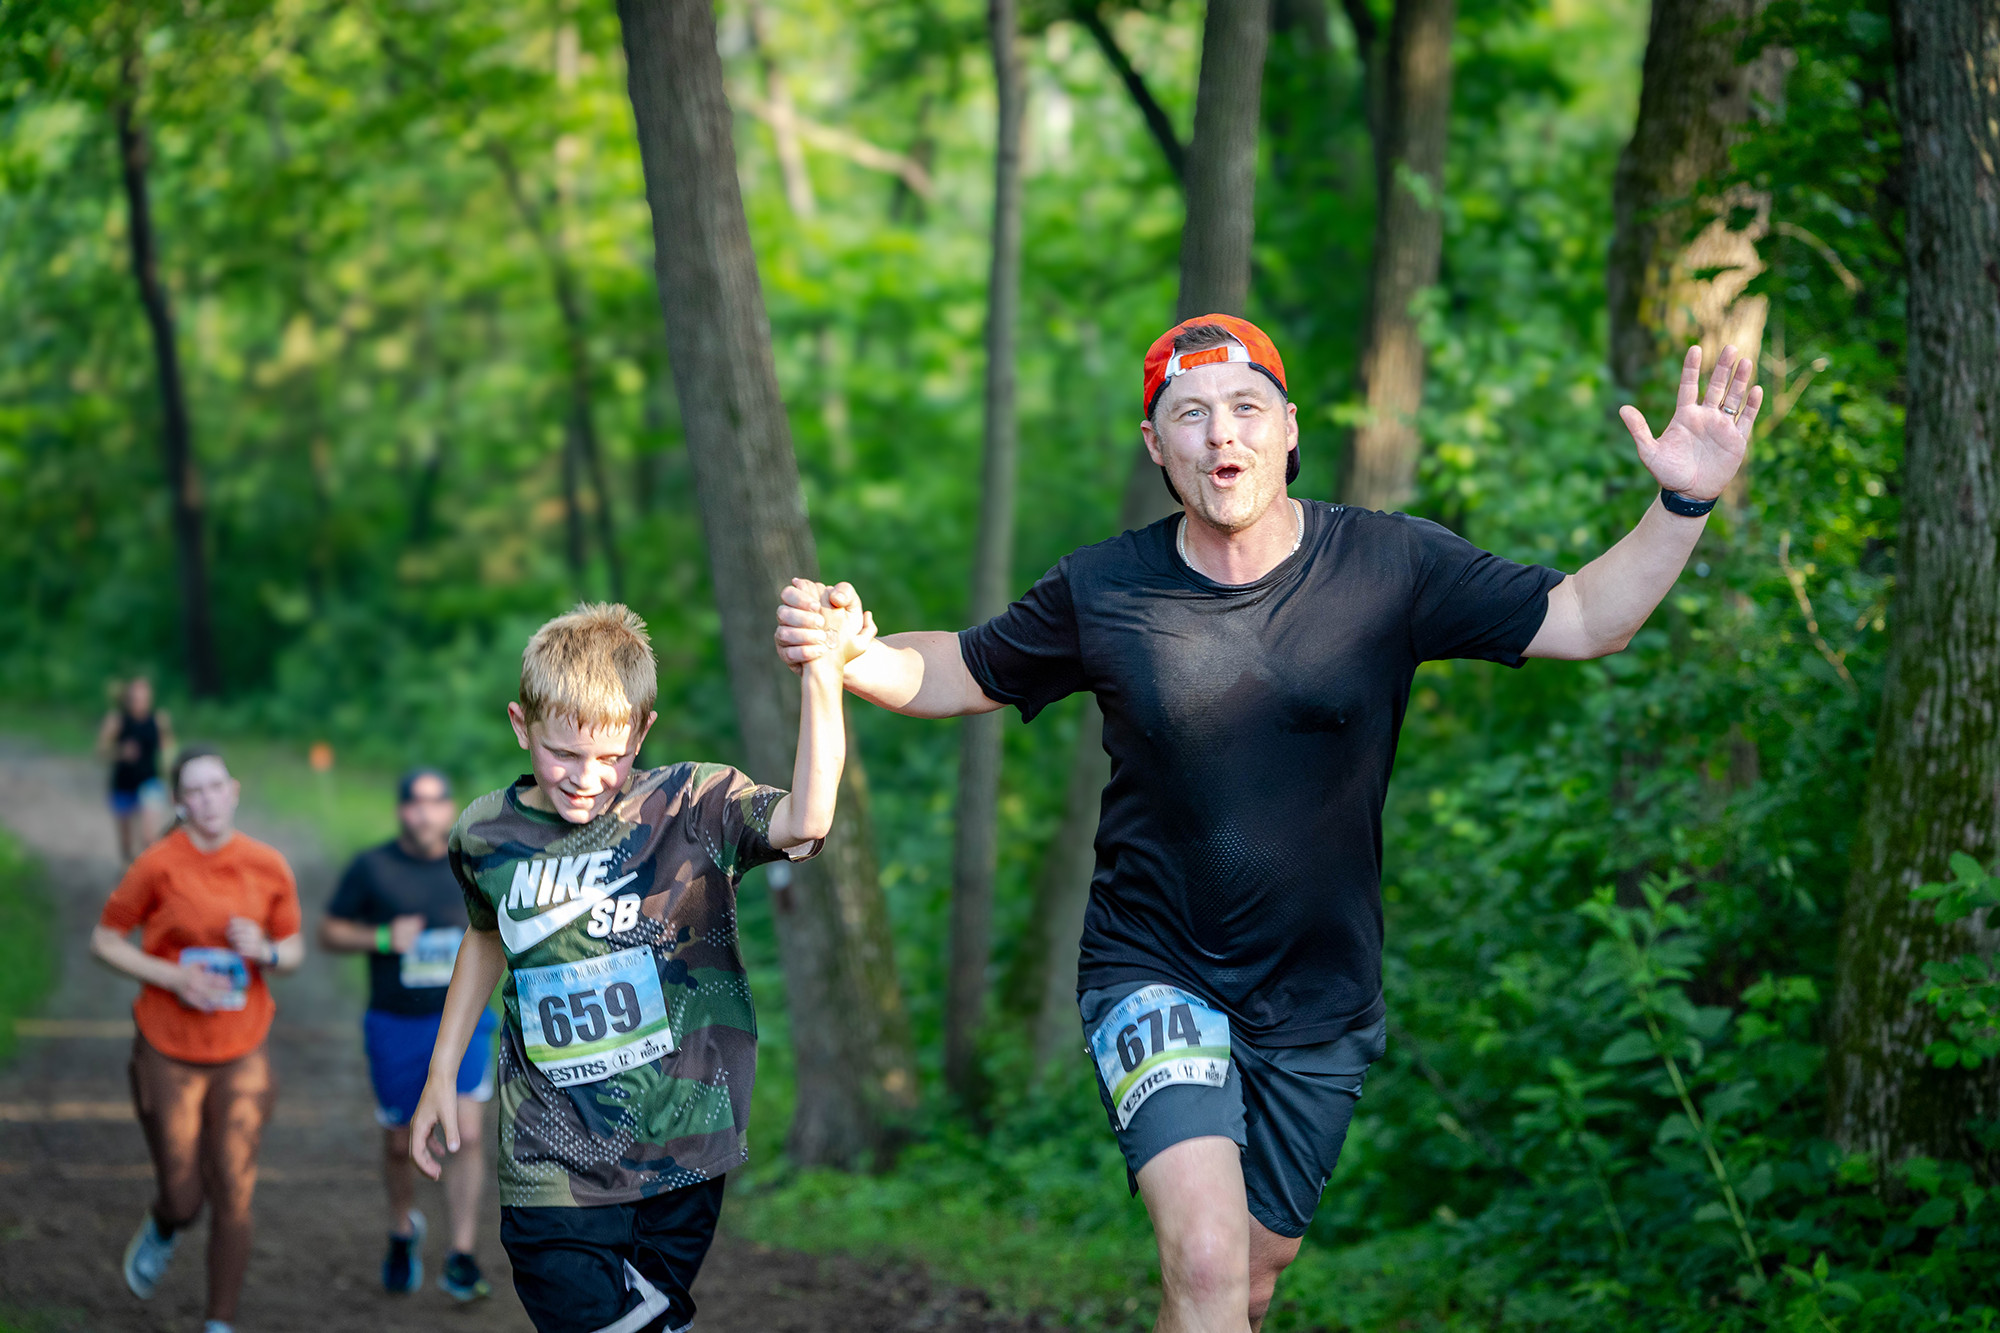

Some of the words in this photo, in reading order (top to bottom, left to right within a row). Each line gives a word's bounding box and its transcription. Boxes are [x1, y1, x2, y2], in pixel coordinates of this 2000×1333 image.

[508, 850, 613, 909] NIKE
[587, 893, 642, 938] SB
[538, 981, 642, 1048] 659
[1116, 1003, 1202, 1073] 674
